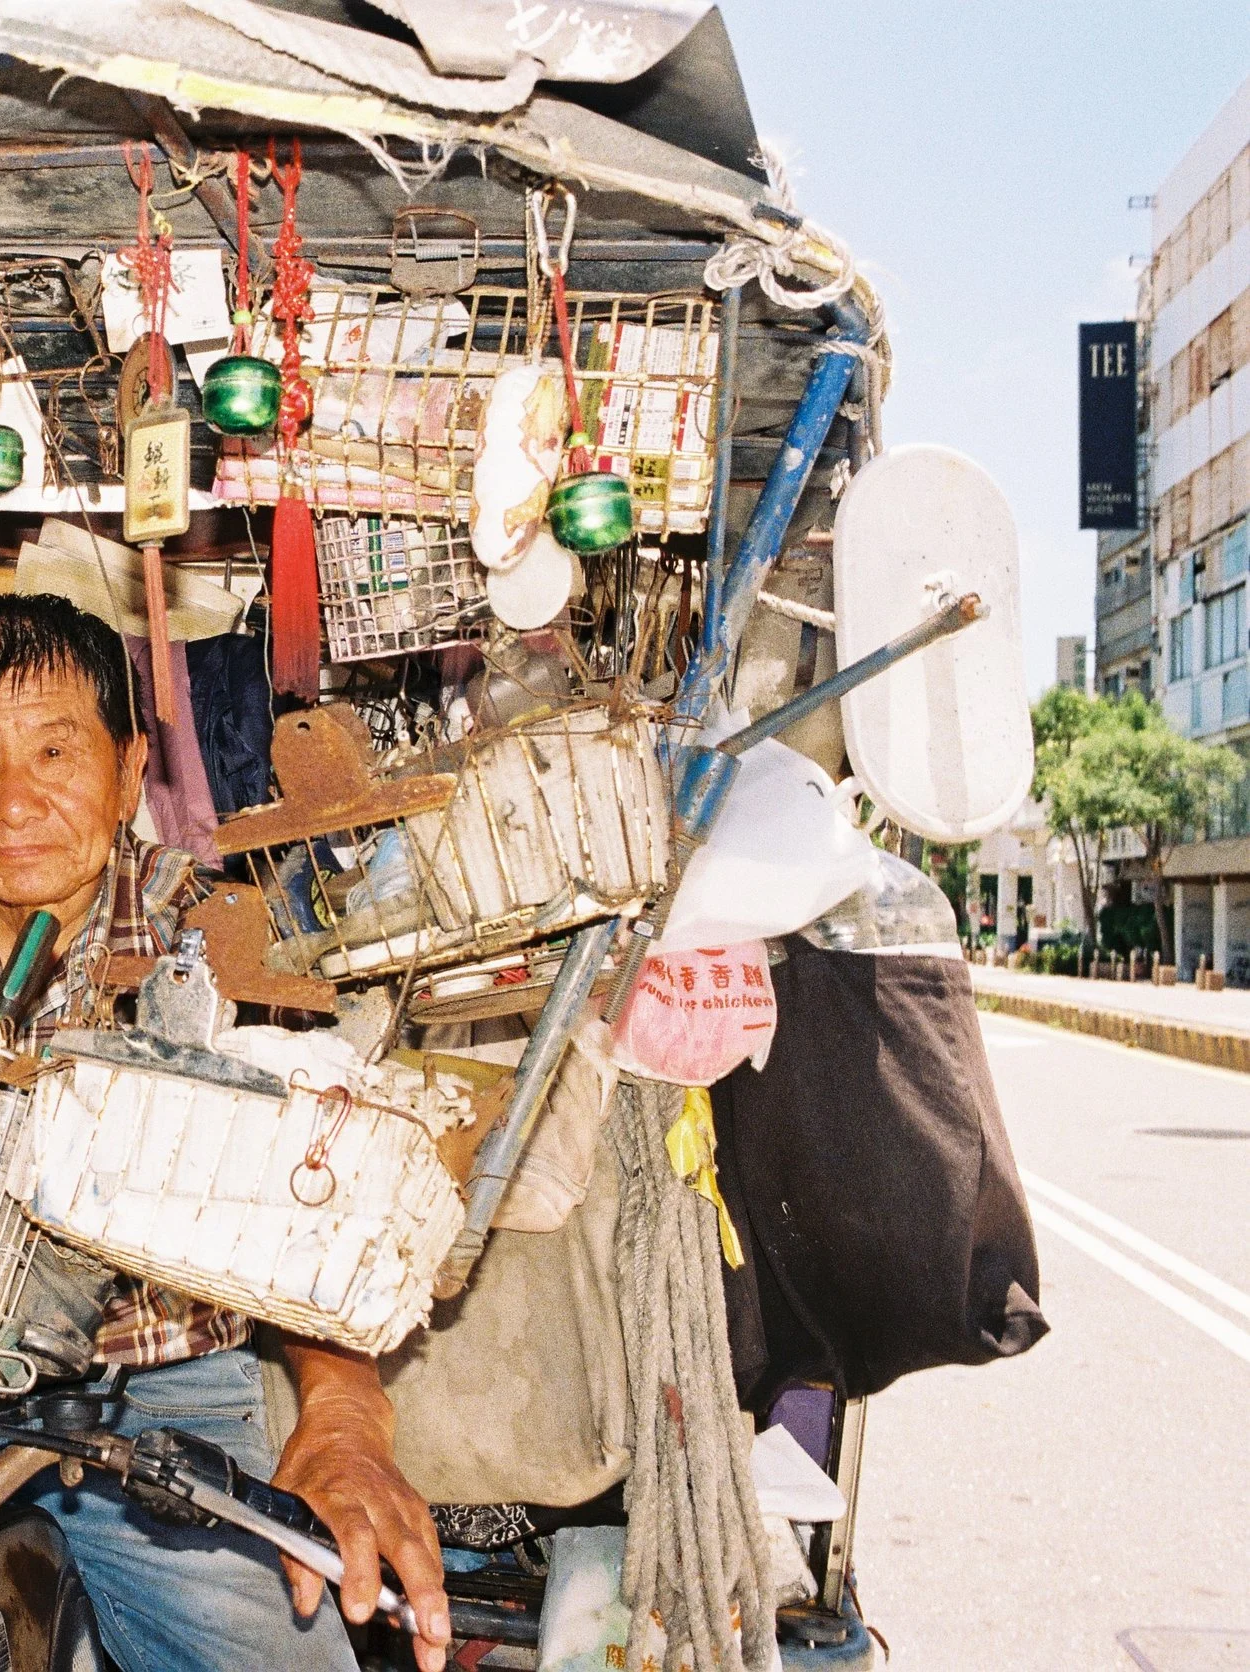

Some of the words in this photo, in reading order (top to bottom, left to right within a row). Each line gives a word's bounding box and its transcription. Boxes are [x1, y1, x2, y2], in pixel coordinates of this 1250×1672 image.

[1089, 343, 1128, 378] TEE
[1086, 482, 1112, 492] MEN
[1087, 492, 1132, 504] WOMEN
[1086, 504, 1113, 516] KIDS
[702, 993, 773, 1009] chicken
